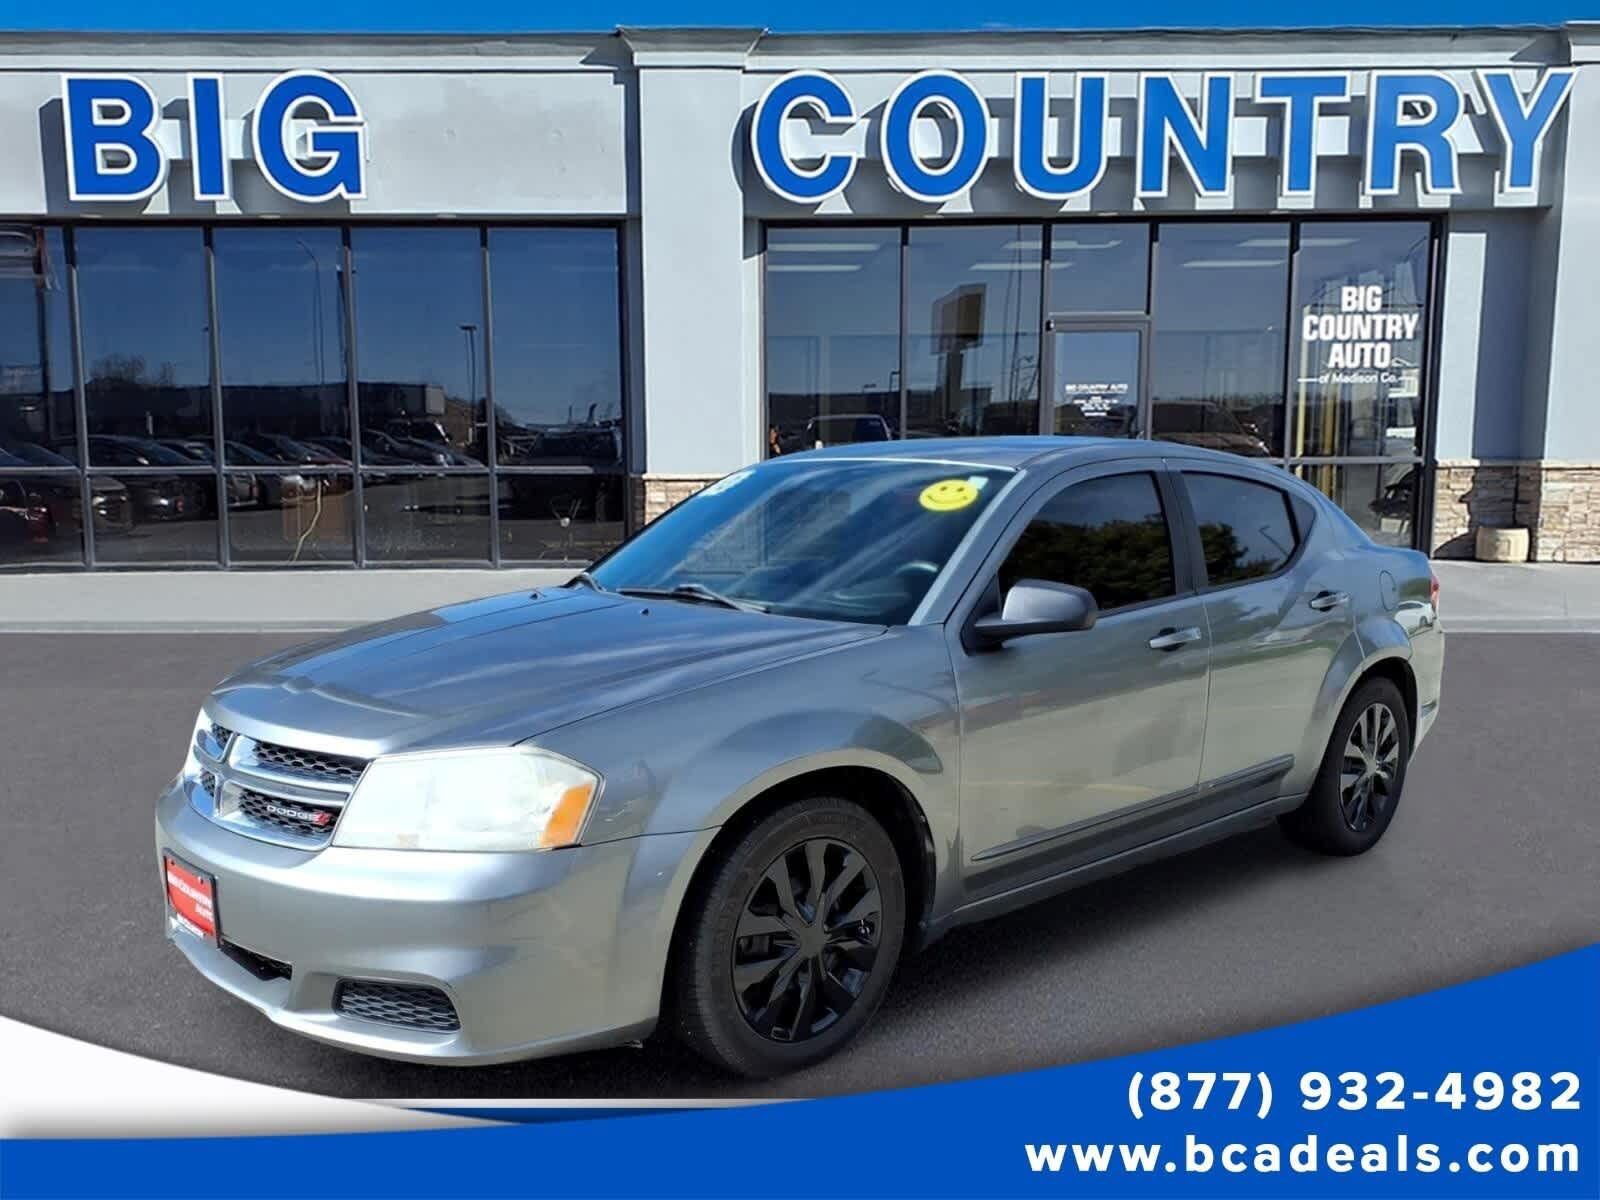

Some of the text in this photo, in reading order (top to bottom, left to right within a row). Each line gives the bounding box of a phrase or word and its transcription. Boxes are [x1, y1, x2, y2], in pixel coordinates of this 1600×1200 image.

[62, 67, 1575, 204] BIG COUNTRY
[1341, 285, 1382, 312] BIG
[1302, 313, 1419, 341] COUNTRY
[1327, 341, 1392, 369] AUTO
[1319, 371, 1332, 384] of
[1332, 371, 1379, 384] Madison
[266, 804, 316, 821] DODGE
